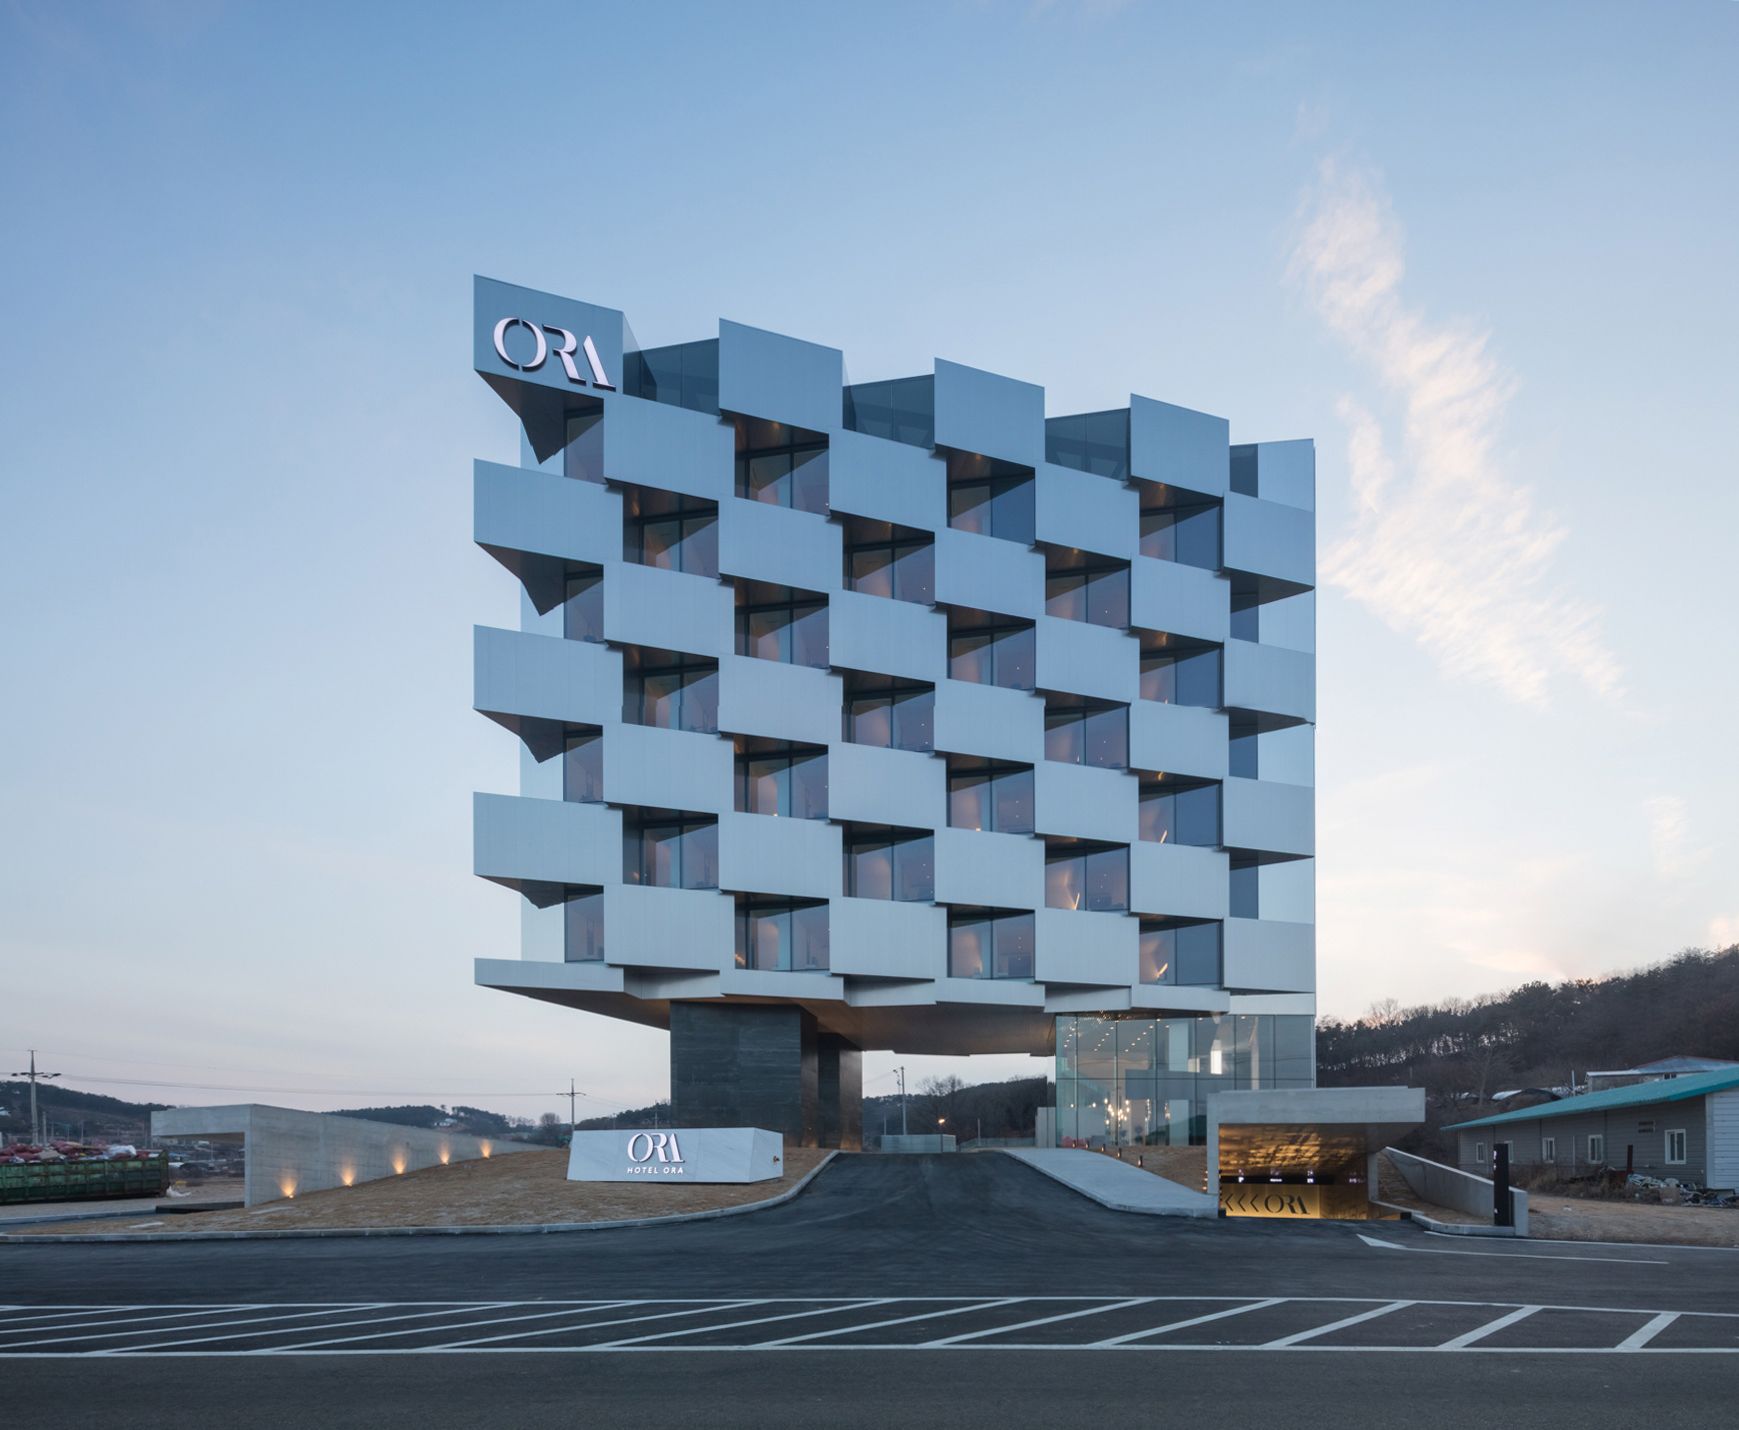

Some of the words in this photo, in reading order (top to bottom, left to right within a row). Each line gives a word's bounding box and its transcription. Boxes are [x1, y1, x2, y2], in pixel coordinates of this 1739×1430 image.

[493, 317, 616, 392] ORA
[627, 1132, 685, 1163] ORA
[627, 1166, 659, 1174] HOTEL
[663, 1166, 684, 1174] ORA
[1264, 1194, 1310, 1214] ORA
